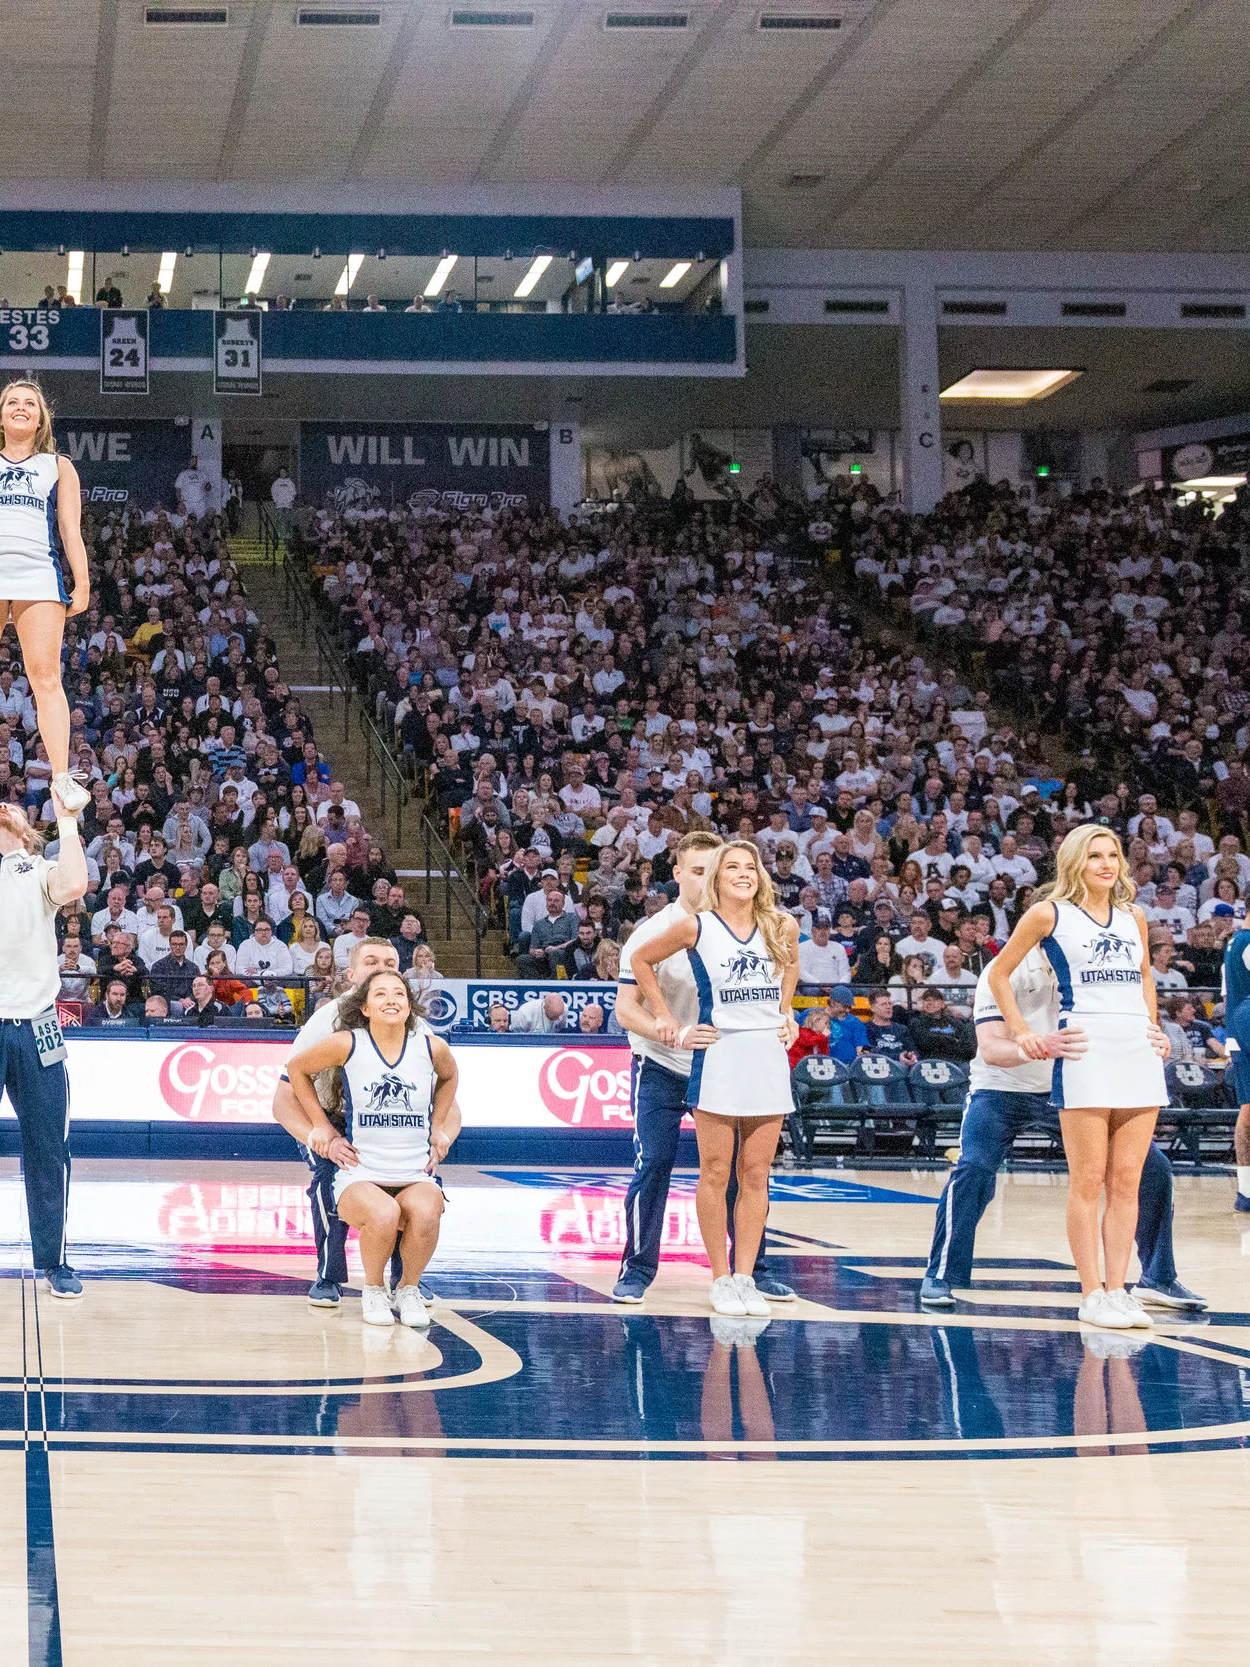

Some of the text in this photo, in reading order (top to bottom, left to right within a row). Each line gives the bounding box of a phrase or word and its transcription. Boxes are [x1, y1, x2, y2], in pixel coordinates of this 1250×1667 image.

[0, 309, 60, 325] ESTES
[9, 325, 50, 350] 33
[110, 348, 141, 367] 24
[225, 350, 251, 367] 31
[200, 426, 213, 440] A
[559, 429, 573, 444] B
[67, 432, 131, 461] WE
[327, 435, 530, 467] WILL WIN
[90, 486, 129, 502] Pro
[13, 494, 46, 512] STATE
[1080, 970, 1114, 984] UTAH
[472, 990, 519, 1008] CBS
[720, 986, 780, 1004] UTAH STATE
[359, 1113, 425, 1128] UTAH STATE
